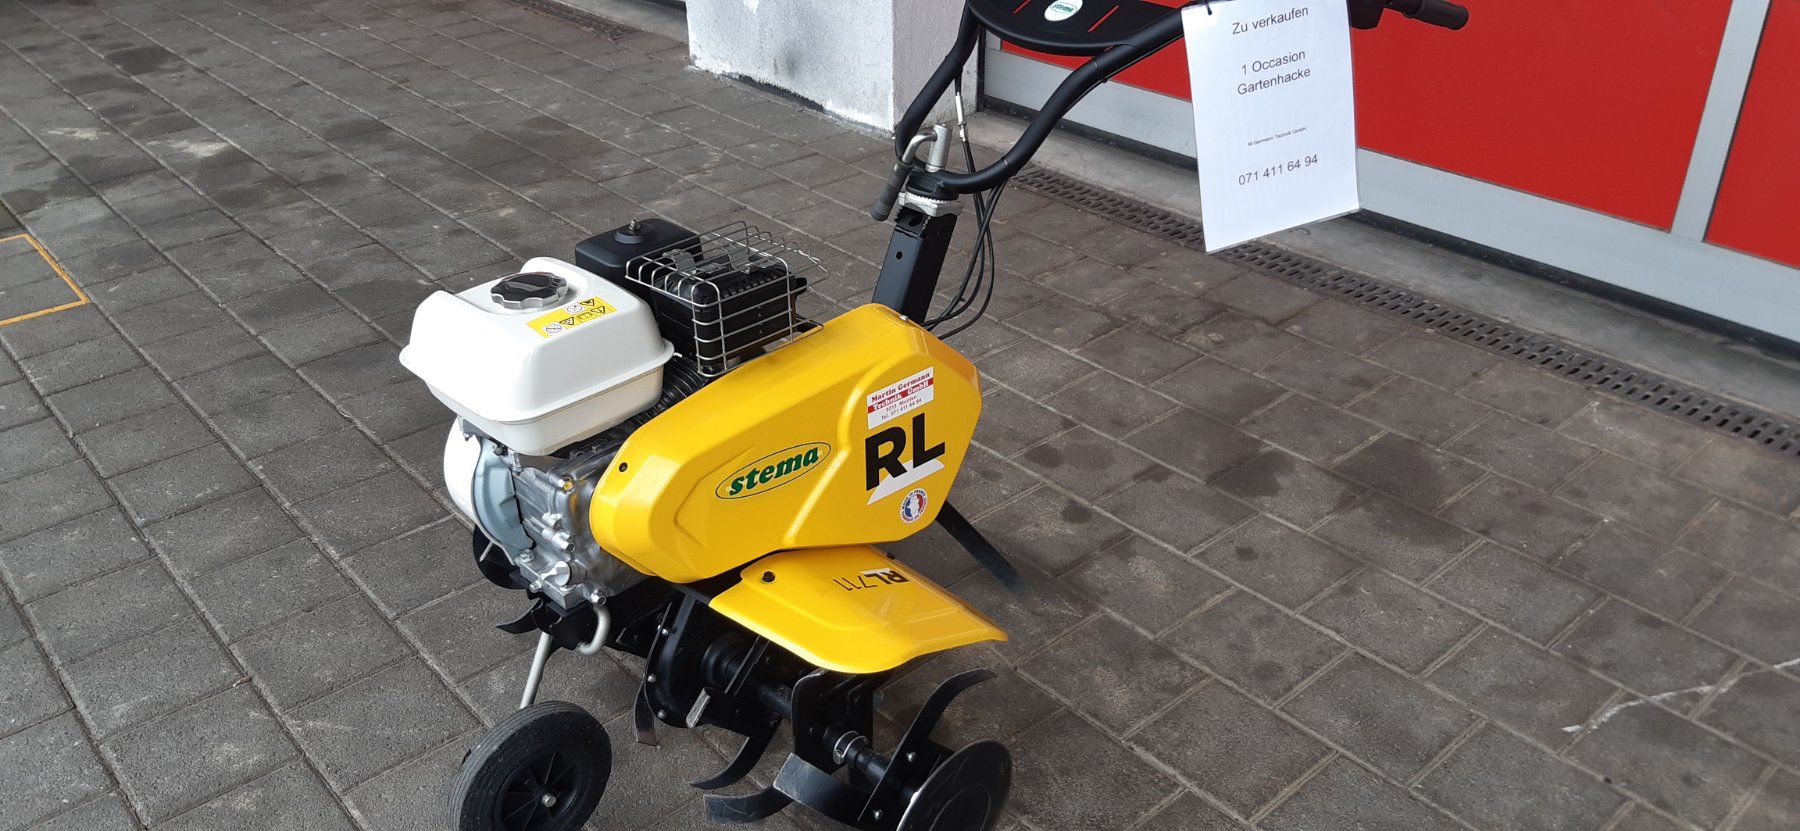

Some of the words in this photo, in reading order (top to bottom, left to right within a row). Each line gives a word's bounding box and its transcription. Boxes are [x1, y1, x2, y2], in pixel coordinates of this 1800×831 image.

[1232, 21, 1248, 35] Zu
[1252, 6, 1309, 30] verkaufen
[1241, 64, 1247, 75] 1
[1252, 50, 1306, 73] Occasion
[1237, 67, 1311, 95] Gartenhacke
[1238, 171, 1259, 186] 071
[1263, 164, 1283, 178] 411
[1287, 159, 1301, 172] 64
[1304, 154, 1318, 167] 94
[871, 388, 896, 402] Martin
[897, 372, 930, 391] Germann
[874, 393, 902, 411] Technik
[907, 380, 929, 395] GmbH
[865, 412, 946, 491] RL
[729, 446, 819, 496] stema
